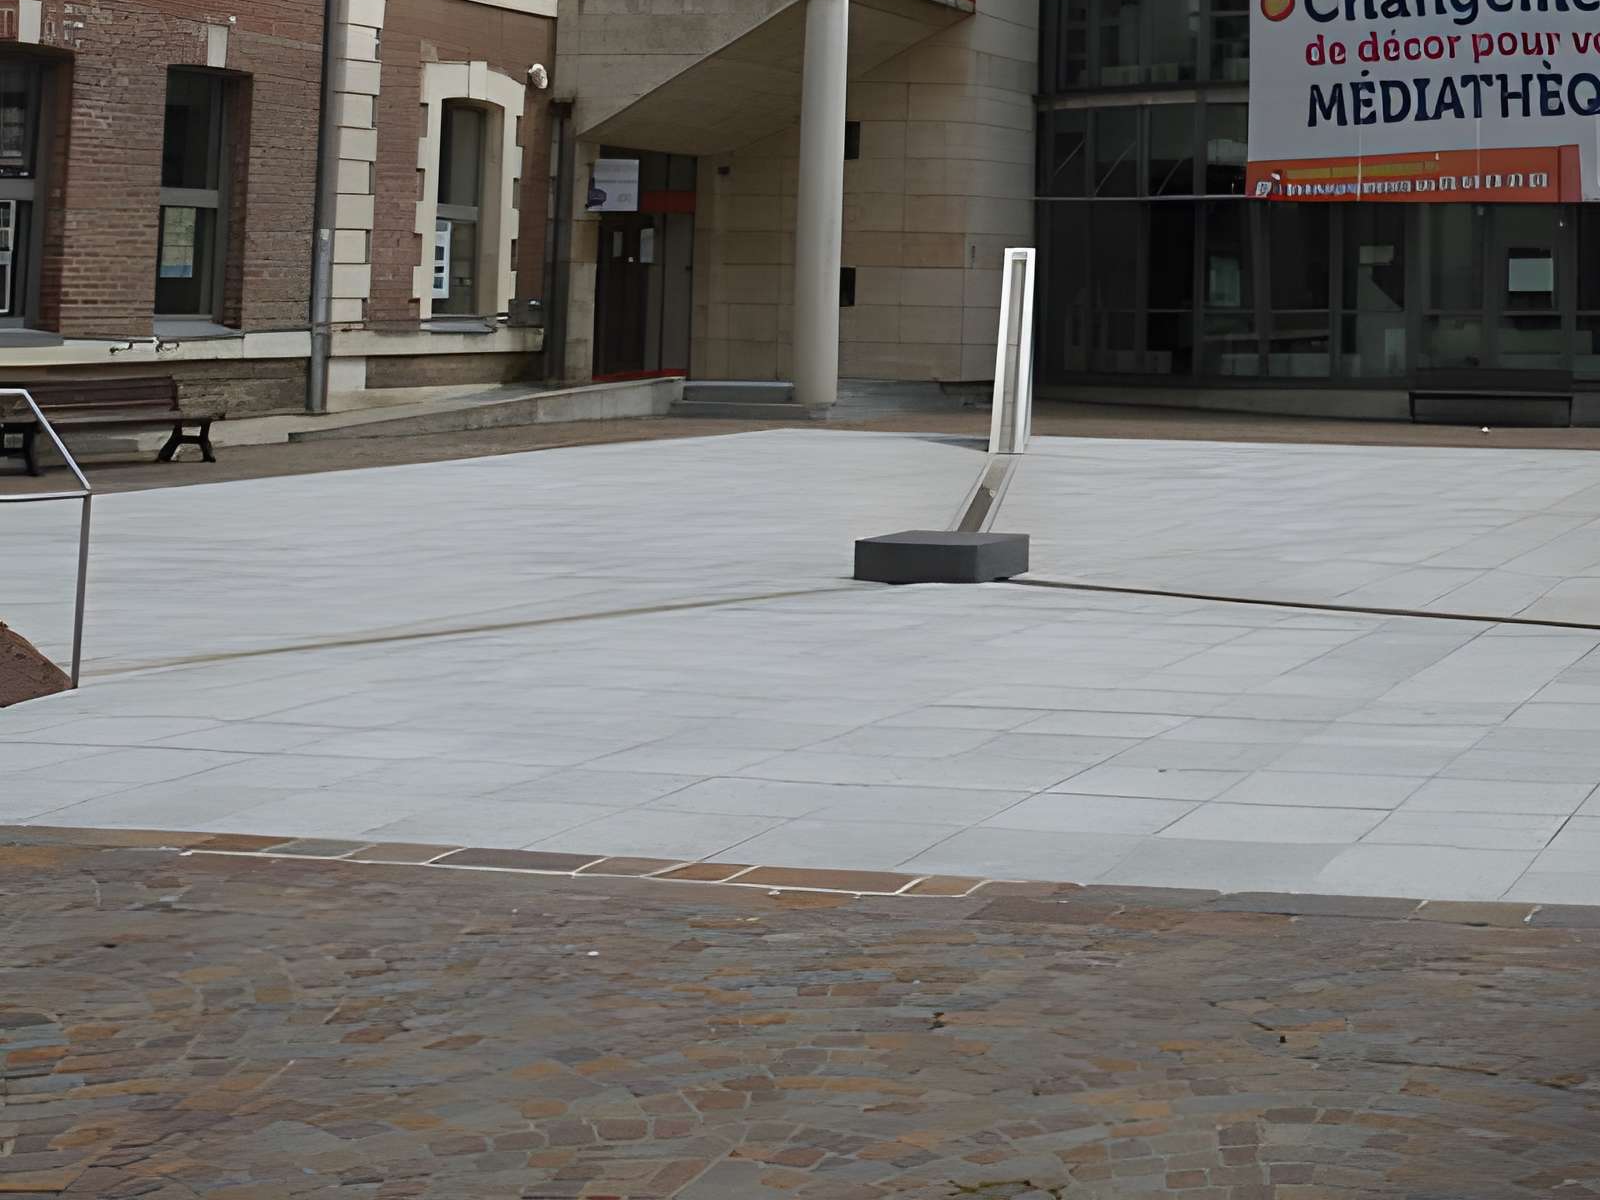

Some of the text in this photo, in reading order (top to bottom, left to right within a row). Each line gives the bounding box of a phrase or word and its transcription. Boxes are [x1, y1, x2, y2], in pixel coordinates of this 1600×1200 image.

[1305, 33, 1347, 65] de
[1358, 30, 1461, 63] décor
[1471, 32, 1561, 63] pour
